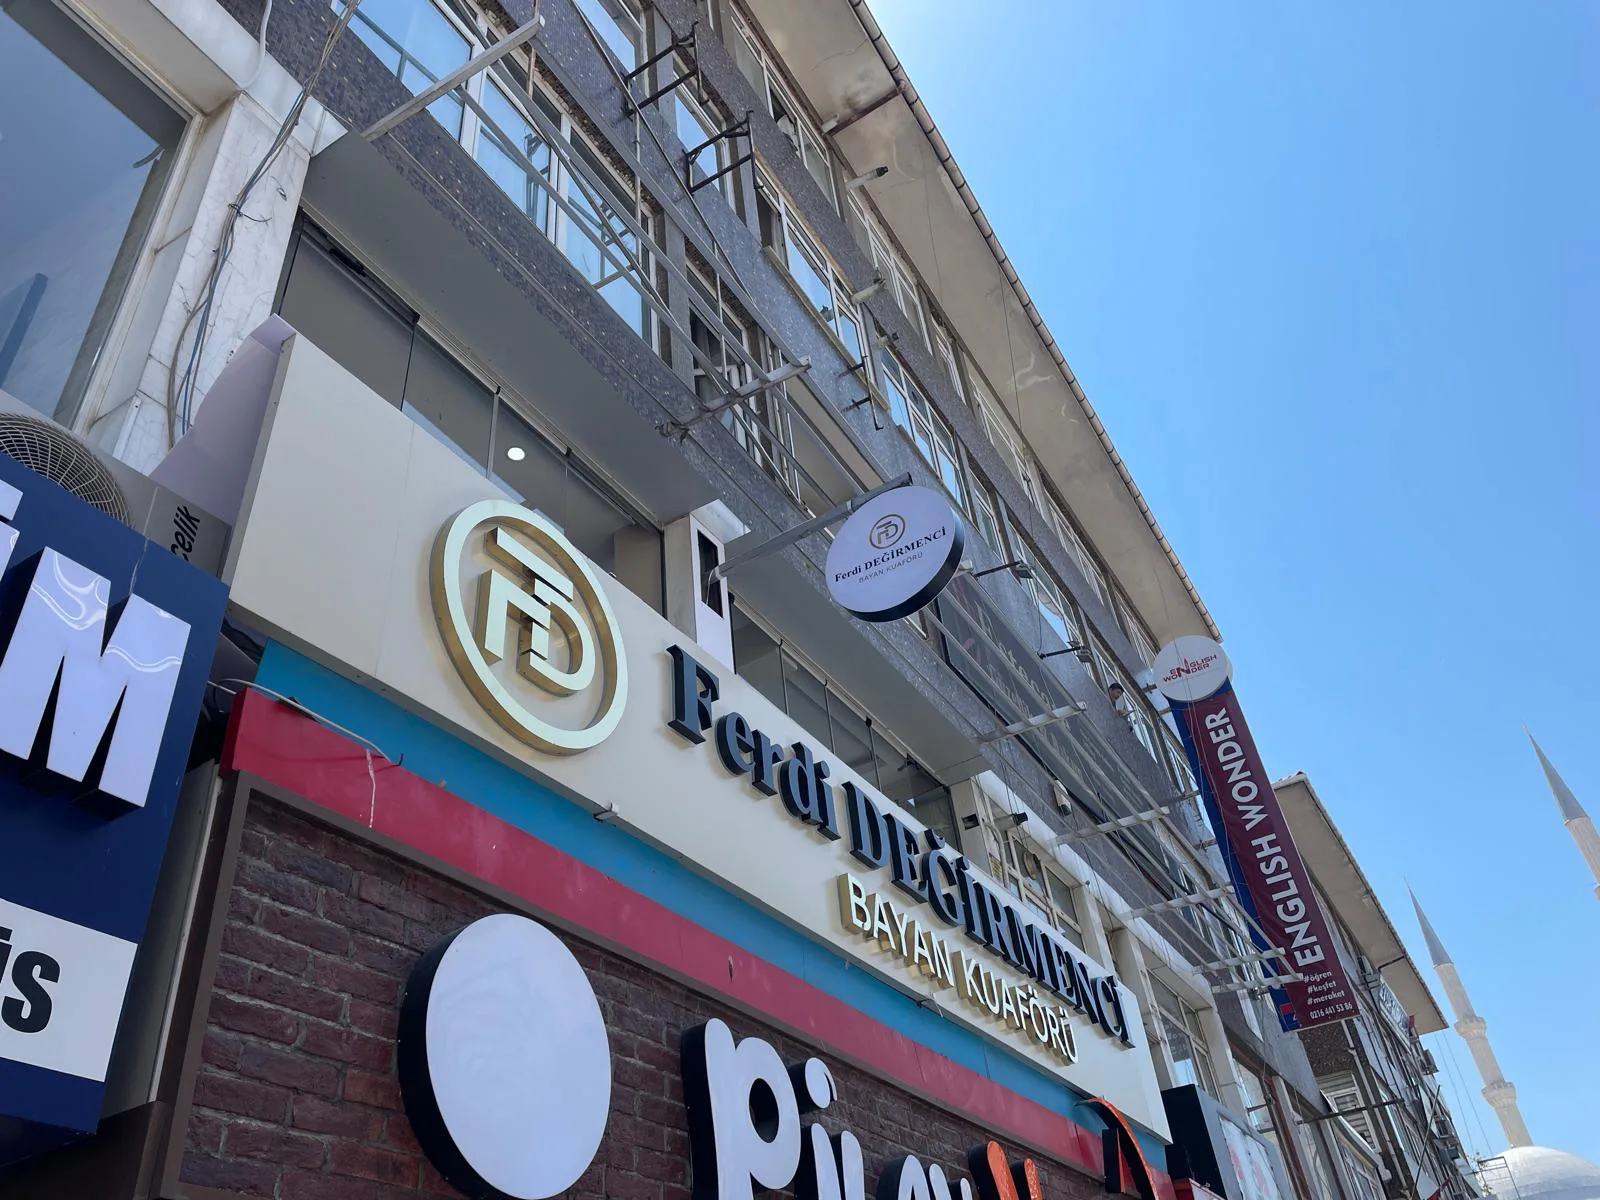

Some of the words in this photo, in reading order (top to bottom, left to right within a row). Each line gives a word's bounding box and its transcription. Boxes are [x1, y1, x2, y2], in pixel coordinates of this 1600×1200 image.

[834, 565, 862, 583] Ferdi
[864, 526, 947, 571] DEĞİRMENCİ
[858, 568, 885, 584] BAYAN
[886, 551, 924, 573] KUAFÖRÜ
[1162, 659, 1210, 683] WONDER
[1169, 653, 1218, 678] ENGLISH
[1205, 707, 1269, 832] WONDER
[665, 644, 842, 841] Ferdi
[842, 781, 1136, 1050] DEĞİRMENCİ
[1250, 833, 1325, 967] ENGLISH
[838, 872, 955, 989] BAYAN
[956, 949, 1079, 1065] KUAFÖRÜ
[1309, 1008, 1325, 1020] 0216
[1325, 1005, 1336, 1016] 441
[1336, 1003, 1345, 1013] 53
